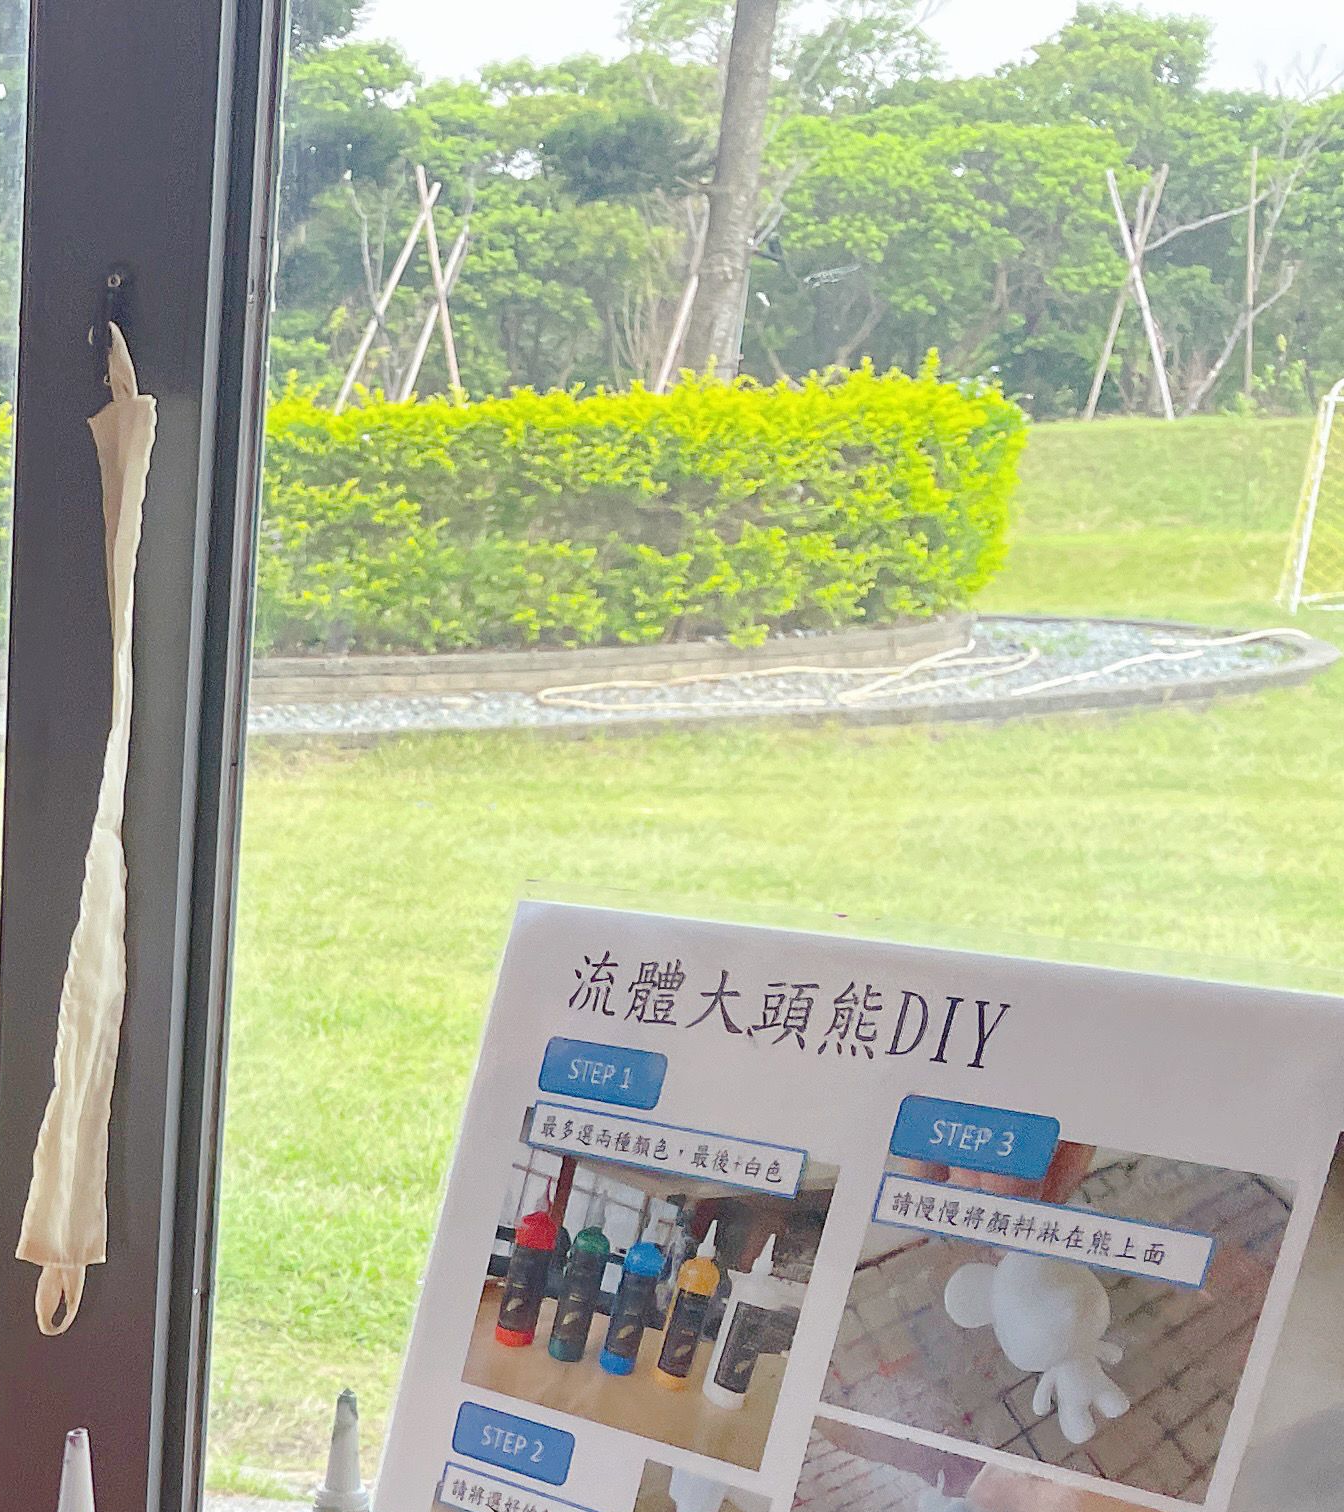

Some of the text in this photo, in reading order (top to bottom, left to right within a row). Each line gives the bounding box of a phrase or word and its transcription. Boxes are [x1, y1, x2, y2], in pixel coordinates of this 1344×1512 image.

[568, 950, 1011, 1069] 流體大頭熊DIY
[567, 1058, 633, 1089] STEP 1
[928, 1119, 1016, 1157] STEP 3
[480, 1424, 545, 1463] STEP 2
